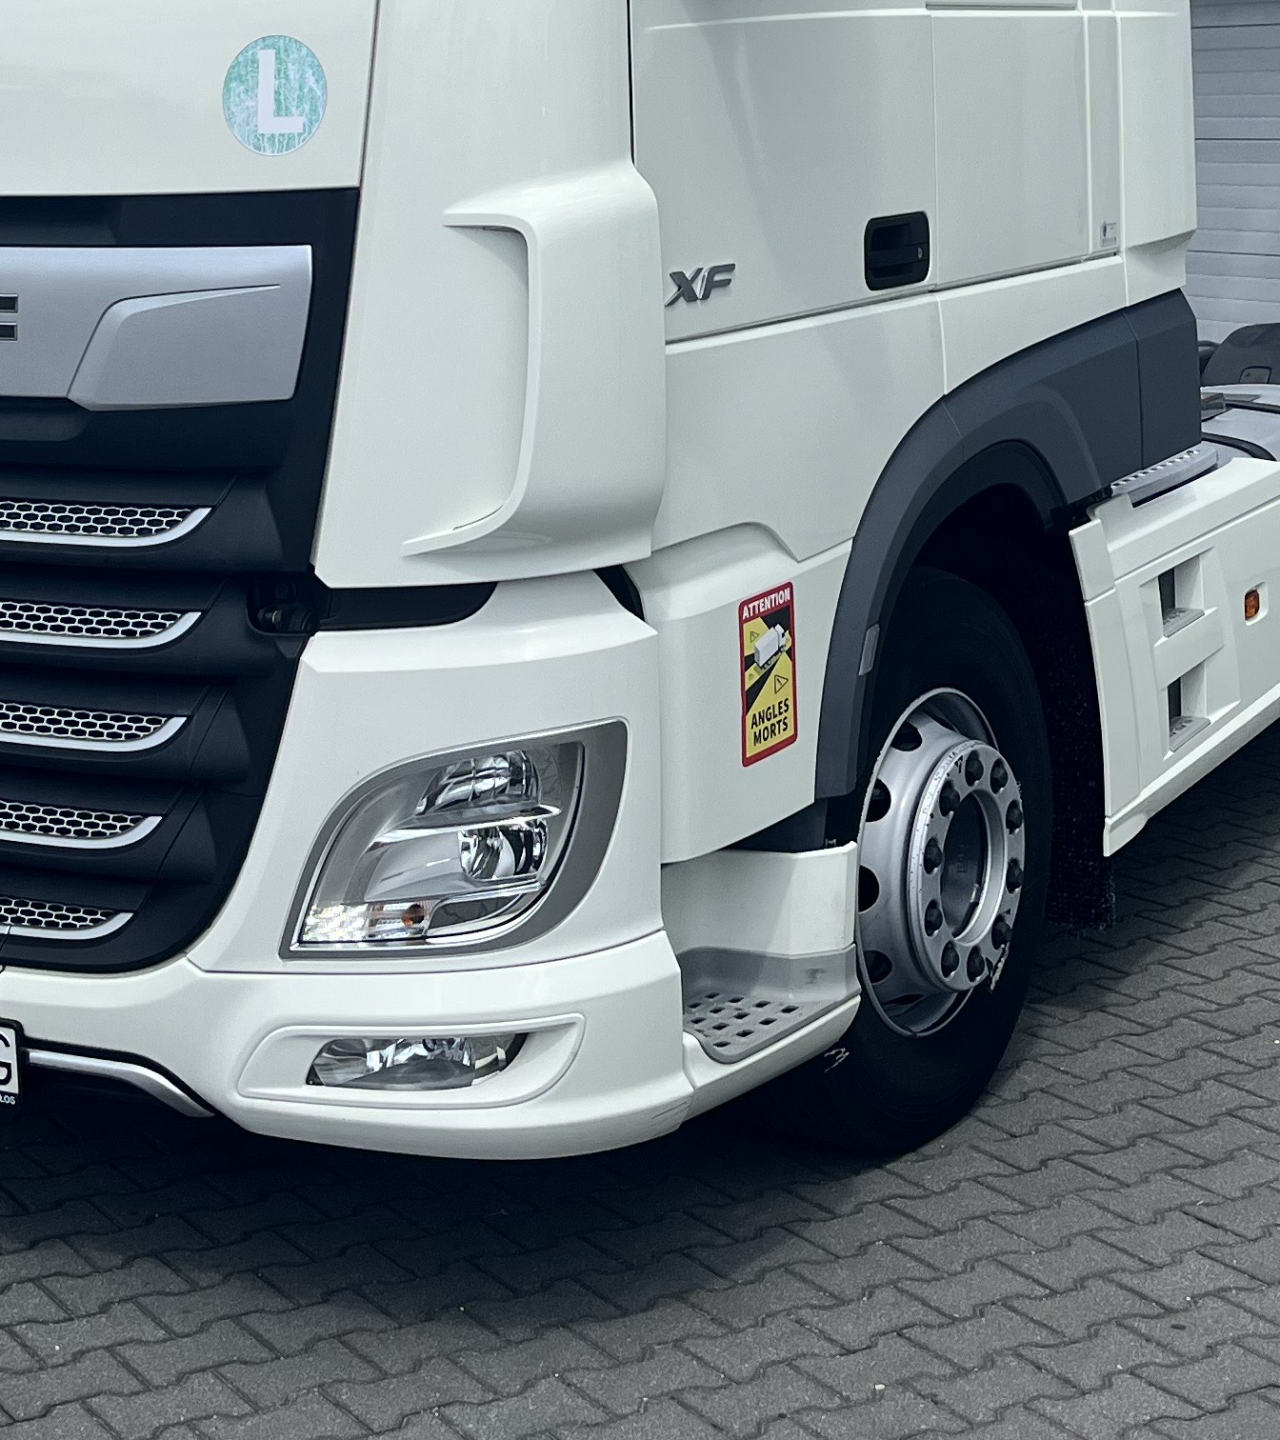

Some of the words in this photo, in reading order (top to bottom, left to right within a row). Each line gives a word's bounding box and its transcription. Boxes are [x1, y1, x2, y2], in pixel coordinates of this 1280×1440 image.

[257, 48, 305, 134] L
[664, 263, 736, 308] XF
[742, 587, 791, 620] ATTENTION
[751, 697, 790, 730] ANGLES
[753, 716, 789, 747] MORTS
